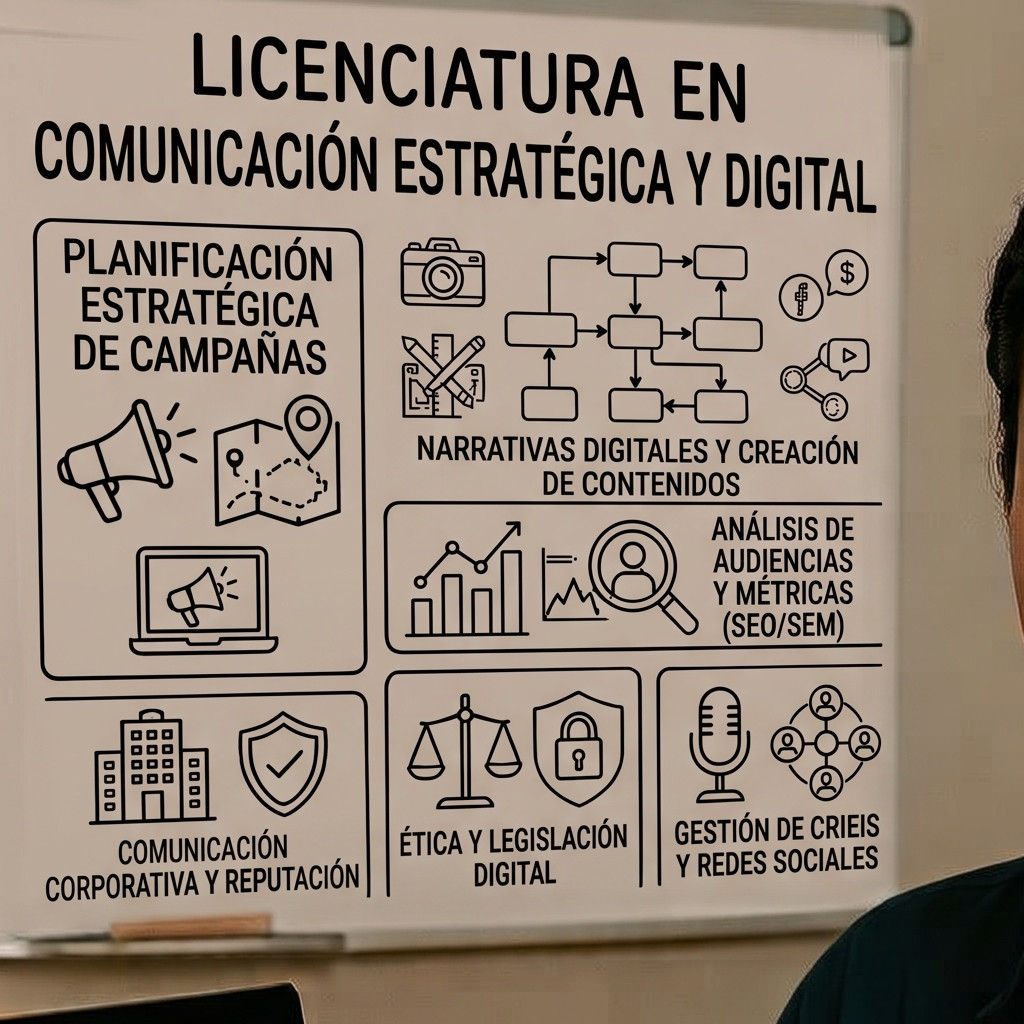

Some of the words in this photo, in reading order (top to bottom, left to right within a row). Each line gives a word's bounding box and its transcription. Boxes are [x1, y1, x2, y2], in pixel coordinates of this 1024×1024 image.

[193, 32, 645, 119] LICENCIATURA
[673, 59, 746, 124] EN
[34, 119, 378, 192] COMUNICACIÓN
[394, 130, 675, 206] ESTRATÉGICA
[685, 150, 712, 206] Y
[725, 152, 877, 214] DIGITAL
[63, 236, 333, 282] PLANIFICACIÓN
[81, 281, 320, 328] ESTRATÉGICA
[74, 333, 120, 371] DE
[130, 329, 327, 376] CAMPAÑAS
[417, 435, 576, 463] NARRATIVAS
[584, 437, 708, 464] DIGITALES
[715, 439, 731, 464] Y
[738, 434, 859, 465] CREACIÓN
[543, 470, 575, 496] DE
[582, 470, 740, 497] CONTENIDOS
[711, 510, 819, 542] ANÁLISIS
[825, 516, 855, 541] DE
[712, 547, 853, 574] AUDIENCIAS
[713, 580, 729, 606] Y
[736, 574, 854, 606] MÉTRICAS
[723, 609, 845, 645] (SEO/SEM)
[399, 825, 463, 857] ÉTICA
[468, 829, 483, 854] Y
[489, 817, 628, 854] LEGISLACIÓN
[674, 811, 770, 846] GESTIÓN
[777, 816, 805, 841] DE
[810, 813, 880, 840] CRIEIS
[118, 828, 288, 866] COMUNICACIÓN
[675, 853, 691, 878] Y
[697, 849, 767, 878] REDES
[773, 845, 879, 874] SOCIALES
[45, 870, 200, 903] CORPORATIVA
[204, 869, 220, 895] Y
[225, 857, 360, 894] REPUTACIÓN
[474, 859, 557, 887] DIGITAL
